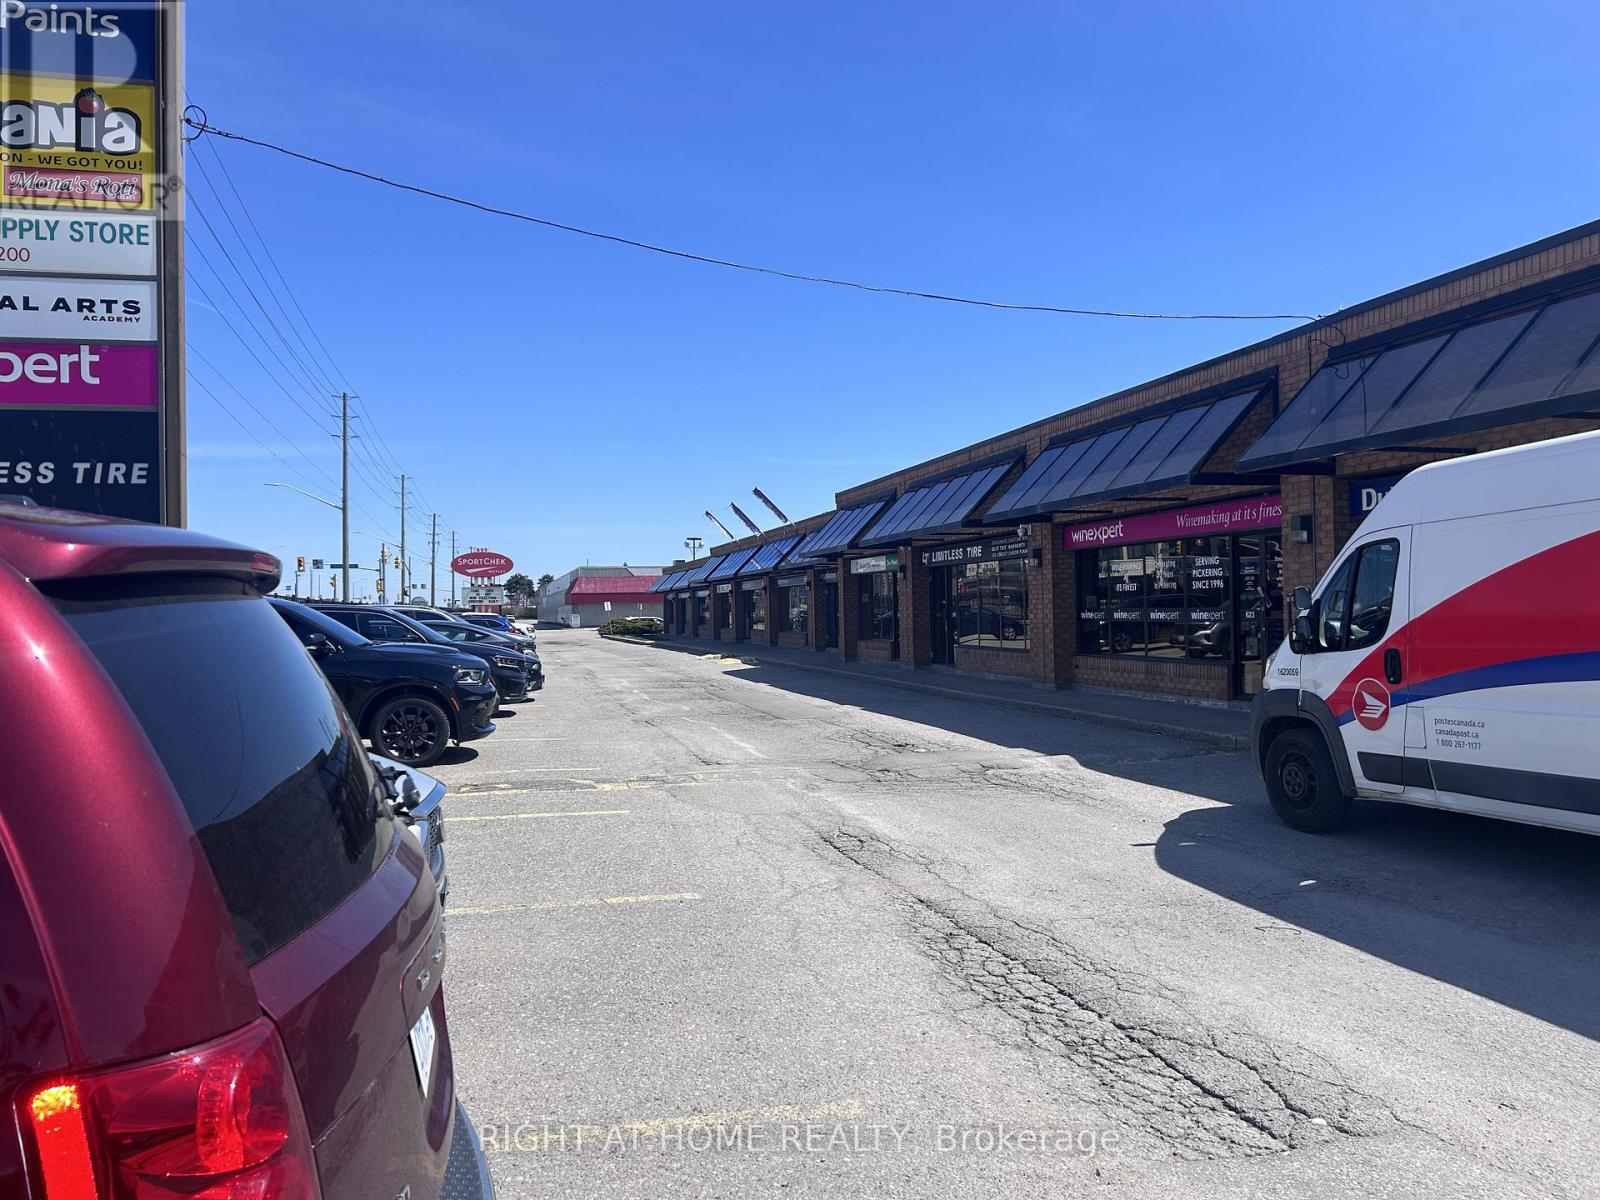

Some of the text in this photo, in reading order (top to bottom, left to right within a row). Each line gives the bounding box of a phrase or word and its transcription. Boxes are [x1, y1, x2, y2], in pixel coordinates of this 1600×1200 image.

[1, 0, 120, 38] Paints
[38, 154, 61, 166] WE
[67, 156, 100, 167] GOT
[104, 159, 142, 170] YOU!
[9, 170, 138, 198] Mona's Roti
[0, 217, 149, 245] PPLY STORE
[0, 246, 30, 263] 200
[0, 295, 141, 315] AL ARTS
[83, 315, 141, 323] ACADEMY
[0, 461, 149, 485] ESS TIRE
[1071, 520, 1124, 544] winexpert
[1176, 510, 1231, 528] Winemaking
[1232, 508, 1242, 522] at
[932, 548, 963, 562] LIMITLESS
[967, 545, 982, 558] TIRE
[1195, 556, 1220, 566] SERVING
[1192, 567, 1223, 578] PICKERING
[1192, 580, 1209, 590] SINCE
[1191, 609, 1224, 620] winexpert
[1434, 718, 1485, 728] postescanada.ca
[1435, 728, 1479, 738] canadapost.ca
[1440, 739, 1453, 747] 800
[1454, 740, 1481, 750] 267-1177
